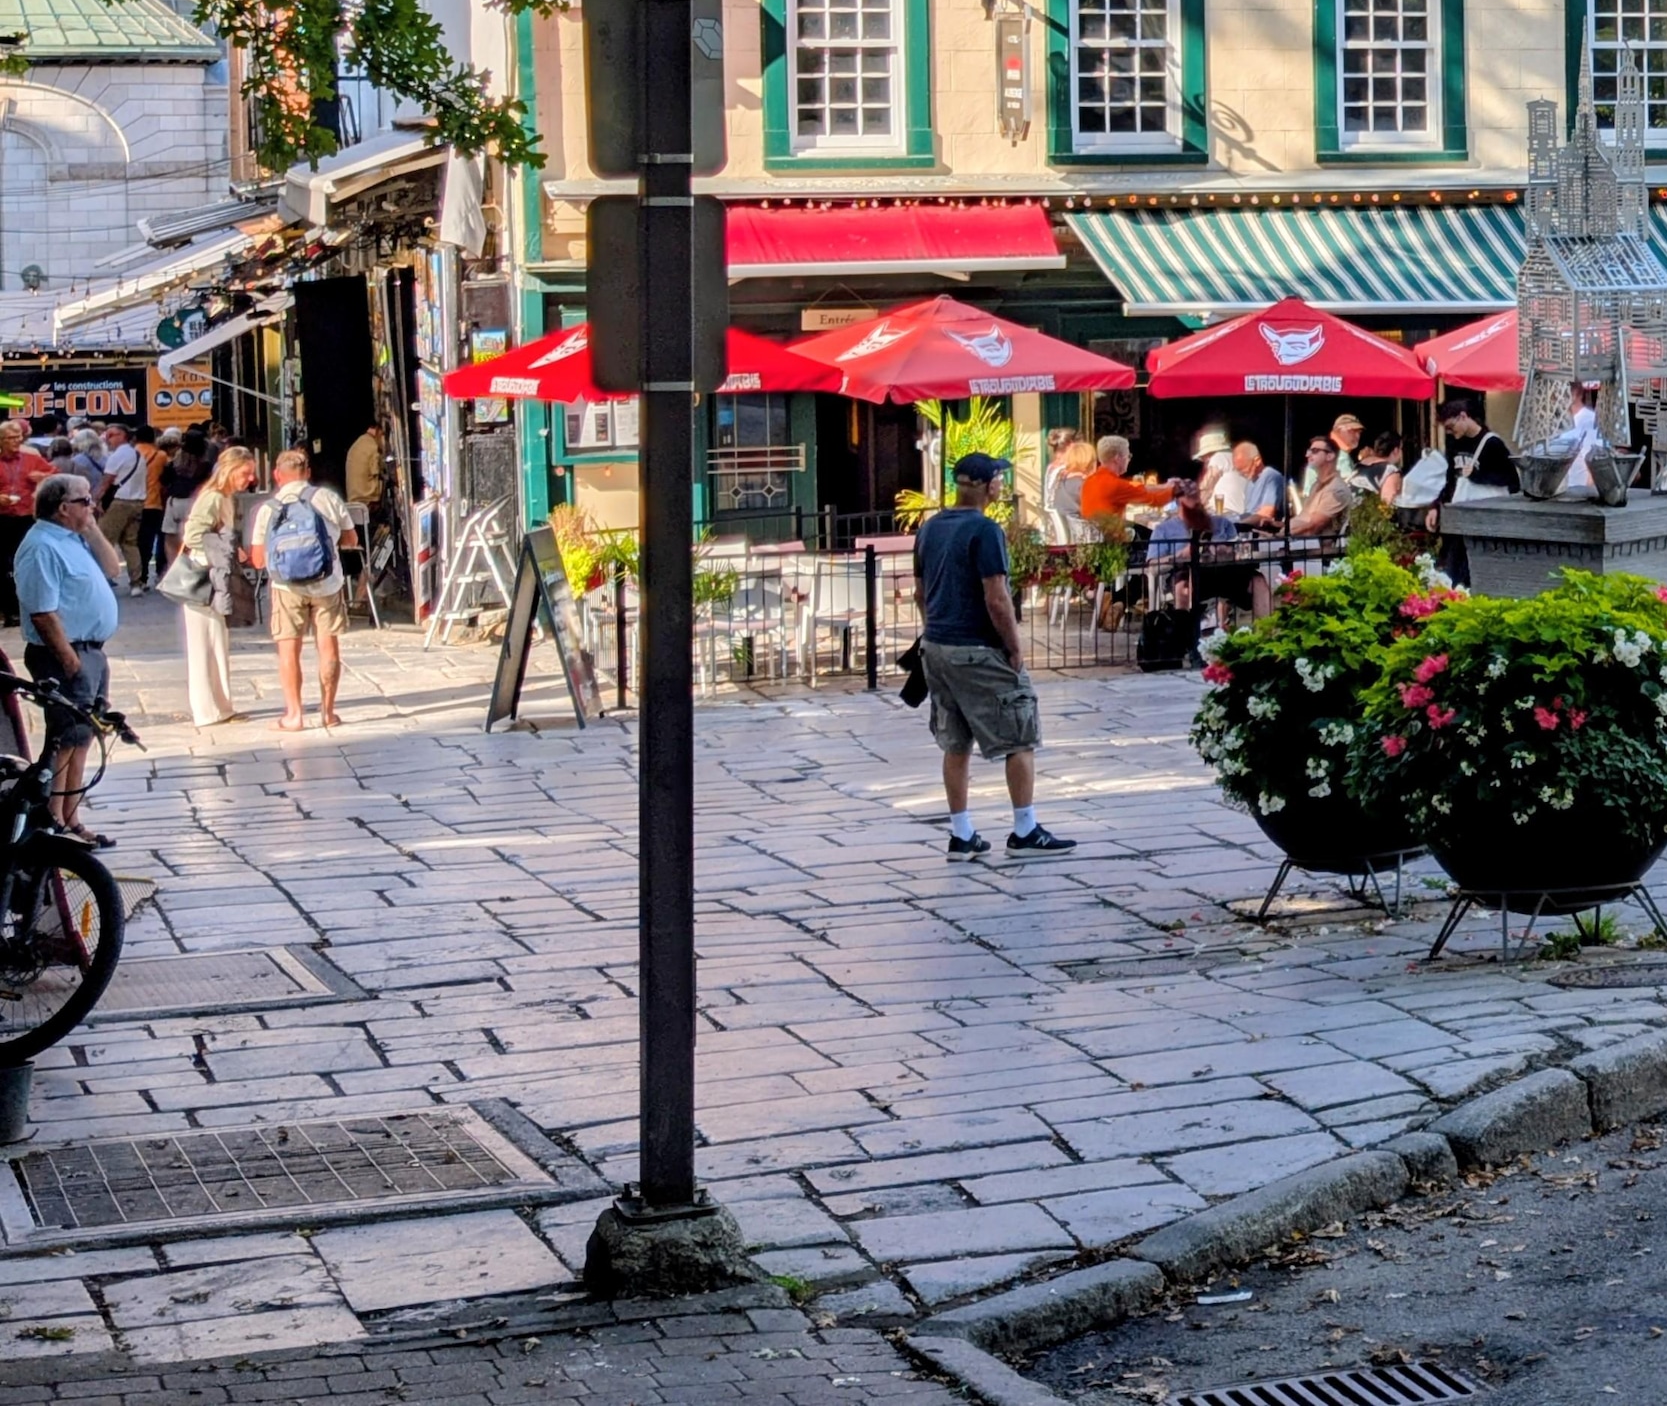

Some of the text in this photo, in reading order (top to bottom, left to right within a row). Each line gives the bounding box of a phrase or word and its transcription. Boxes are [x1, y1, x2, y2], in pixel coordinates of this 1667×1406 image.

[54, 380, 124, 391] les constructions
[8, 384, 137, 419] BÉ-CON
